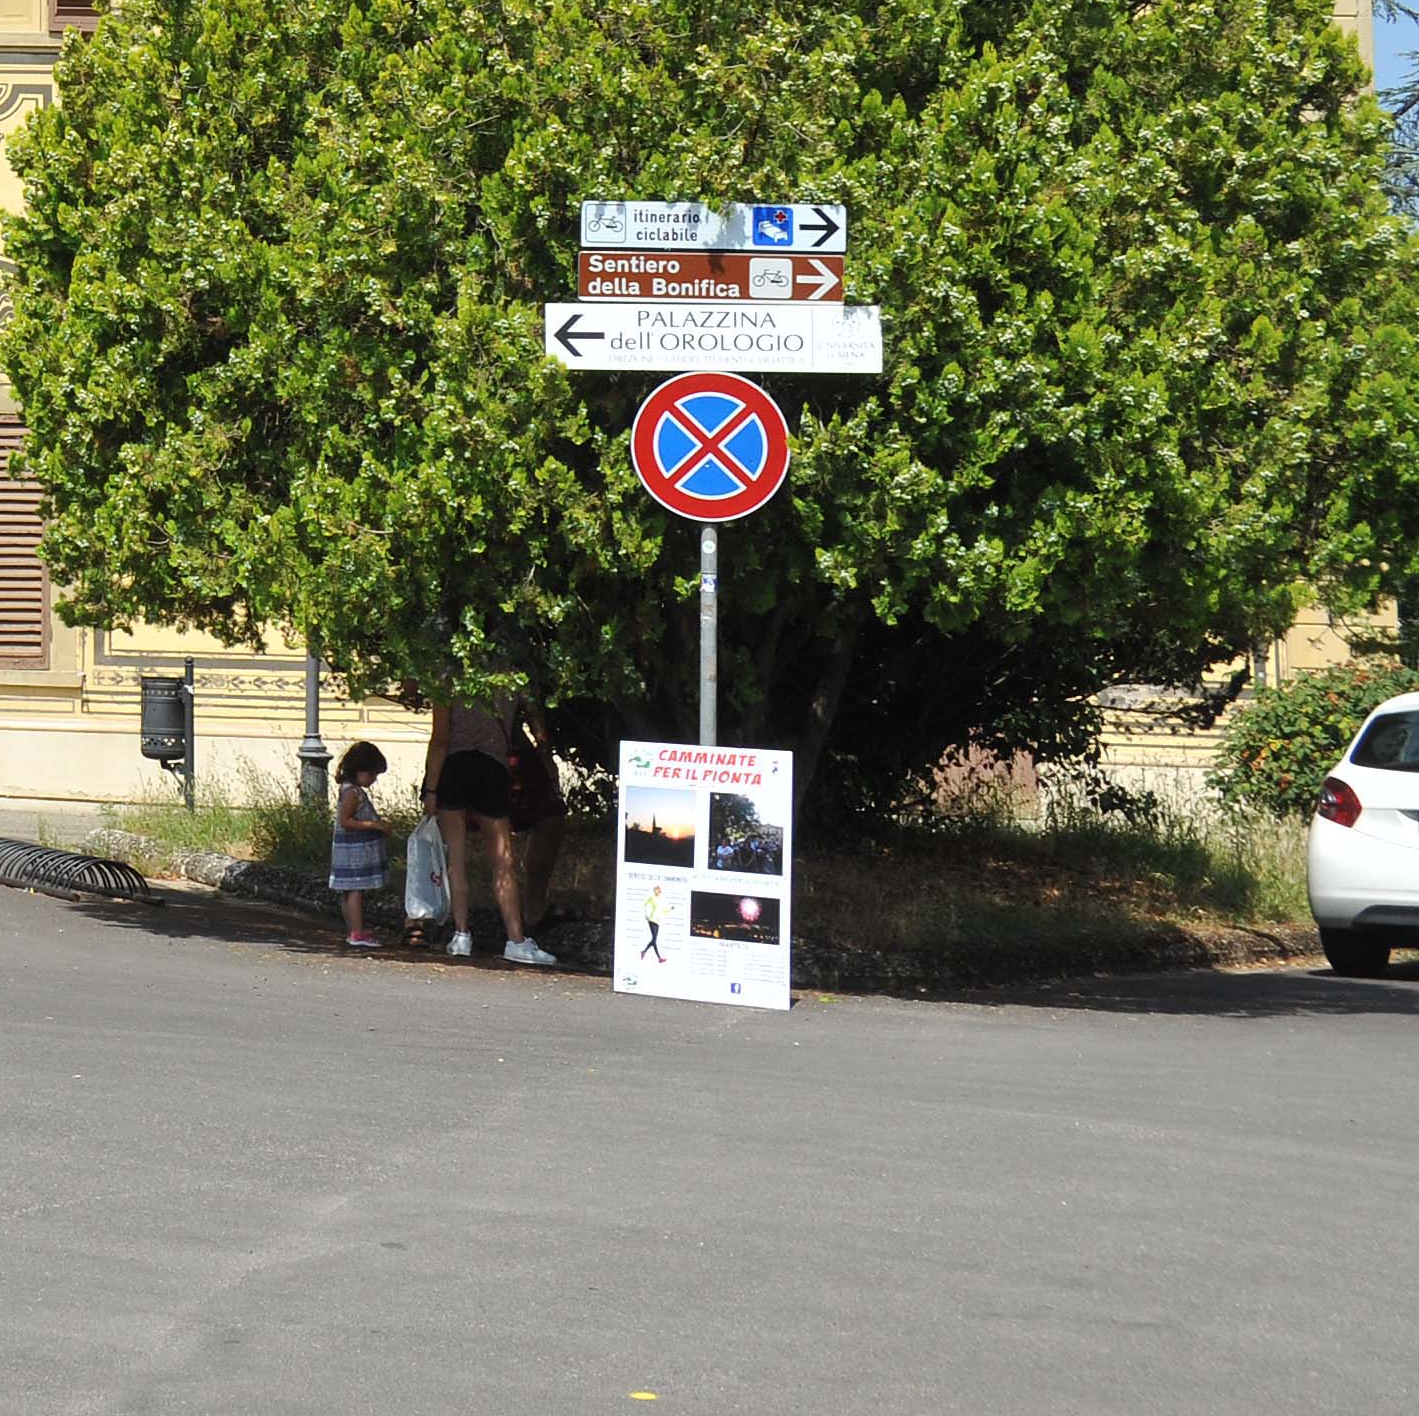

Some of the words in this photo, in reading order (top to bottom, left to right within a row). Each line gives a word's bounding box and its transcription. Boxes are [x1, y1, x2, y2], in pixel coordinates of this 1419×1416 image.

[634, 209, 700, 223] itinerario
[636, 227, 698, 242] ciclabile
[588, 255, 680, 273] Sentiero
[588, 277, 640, 295] della
[652, 278, 740, 297] Bonifica
[637, 310, 777, 328] PALAZZINA
[659, 749, 756, 767] CAMMINATE
[653, 766, 682, 779] PER
[685, 769, 698, 780] IL
[702, 769, 762, 785] PIONTA
